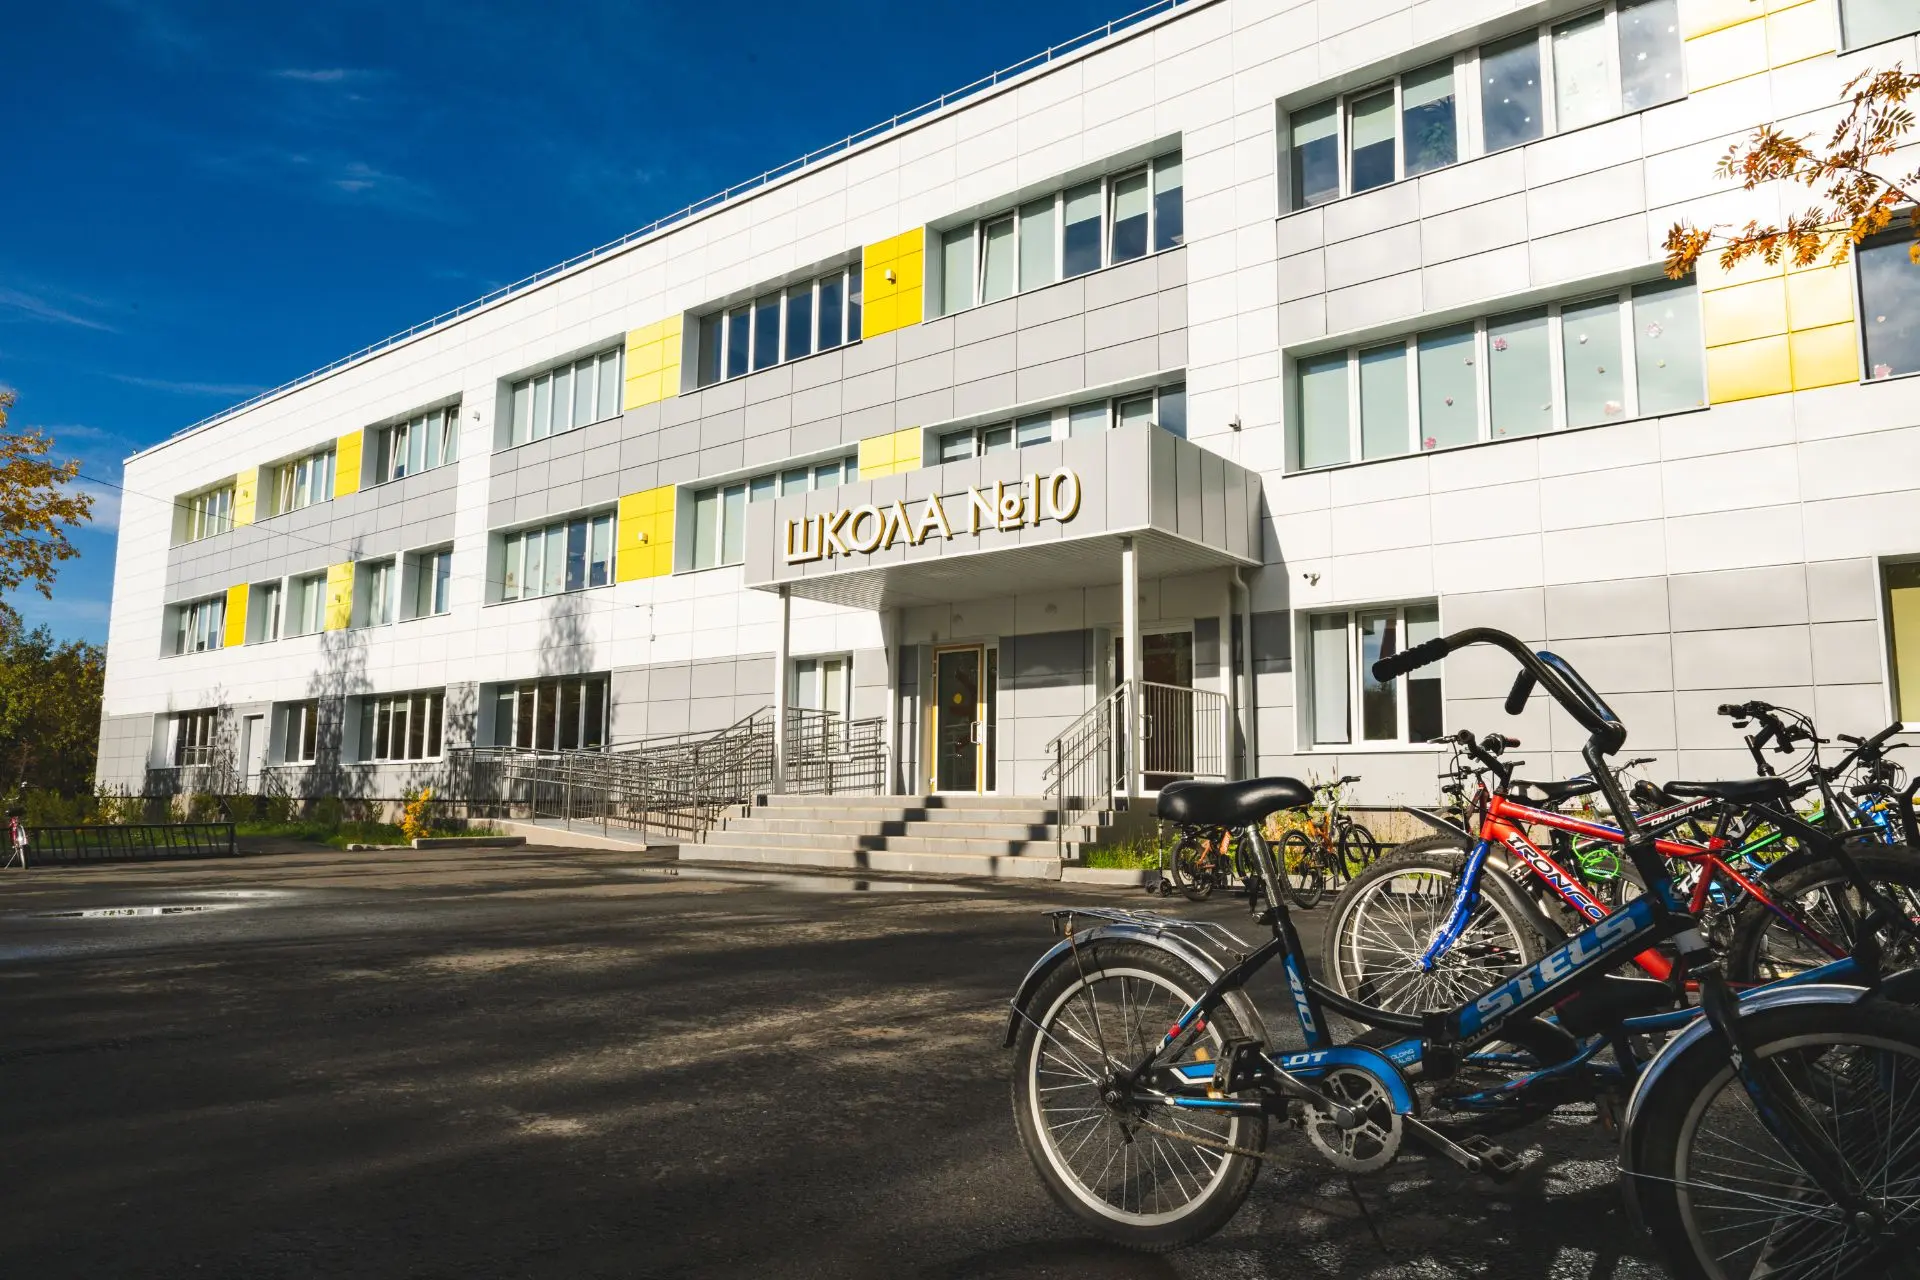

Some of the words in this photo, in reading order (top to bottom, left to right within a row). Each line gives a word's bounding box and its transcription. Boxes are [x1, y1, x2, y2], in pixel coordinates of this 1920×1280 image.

[782, 493, 954, 564] ШКОЛА
[967, 466, 1081, 533] №10
[1507, 833, 1605, 920] IRONFO
[1477, 907, 1637, 1024] STELS
